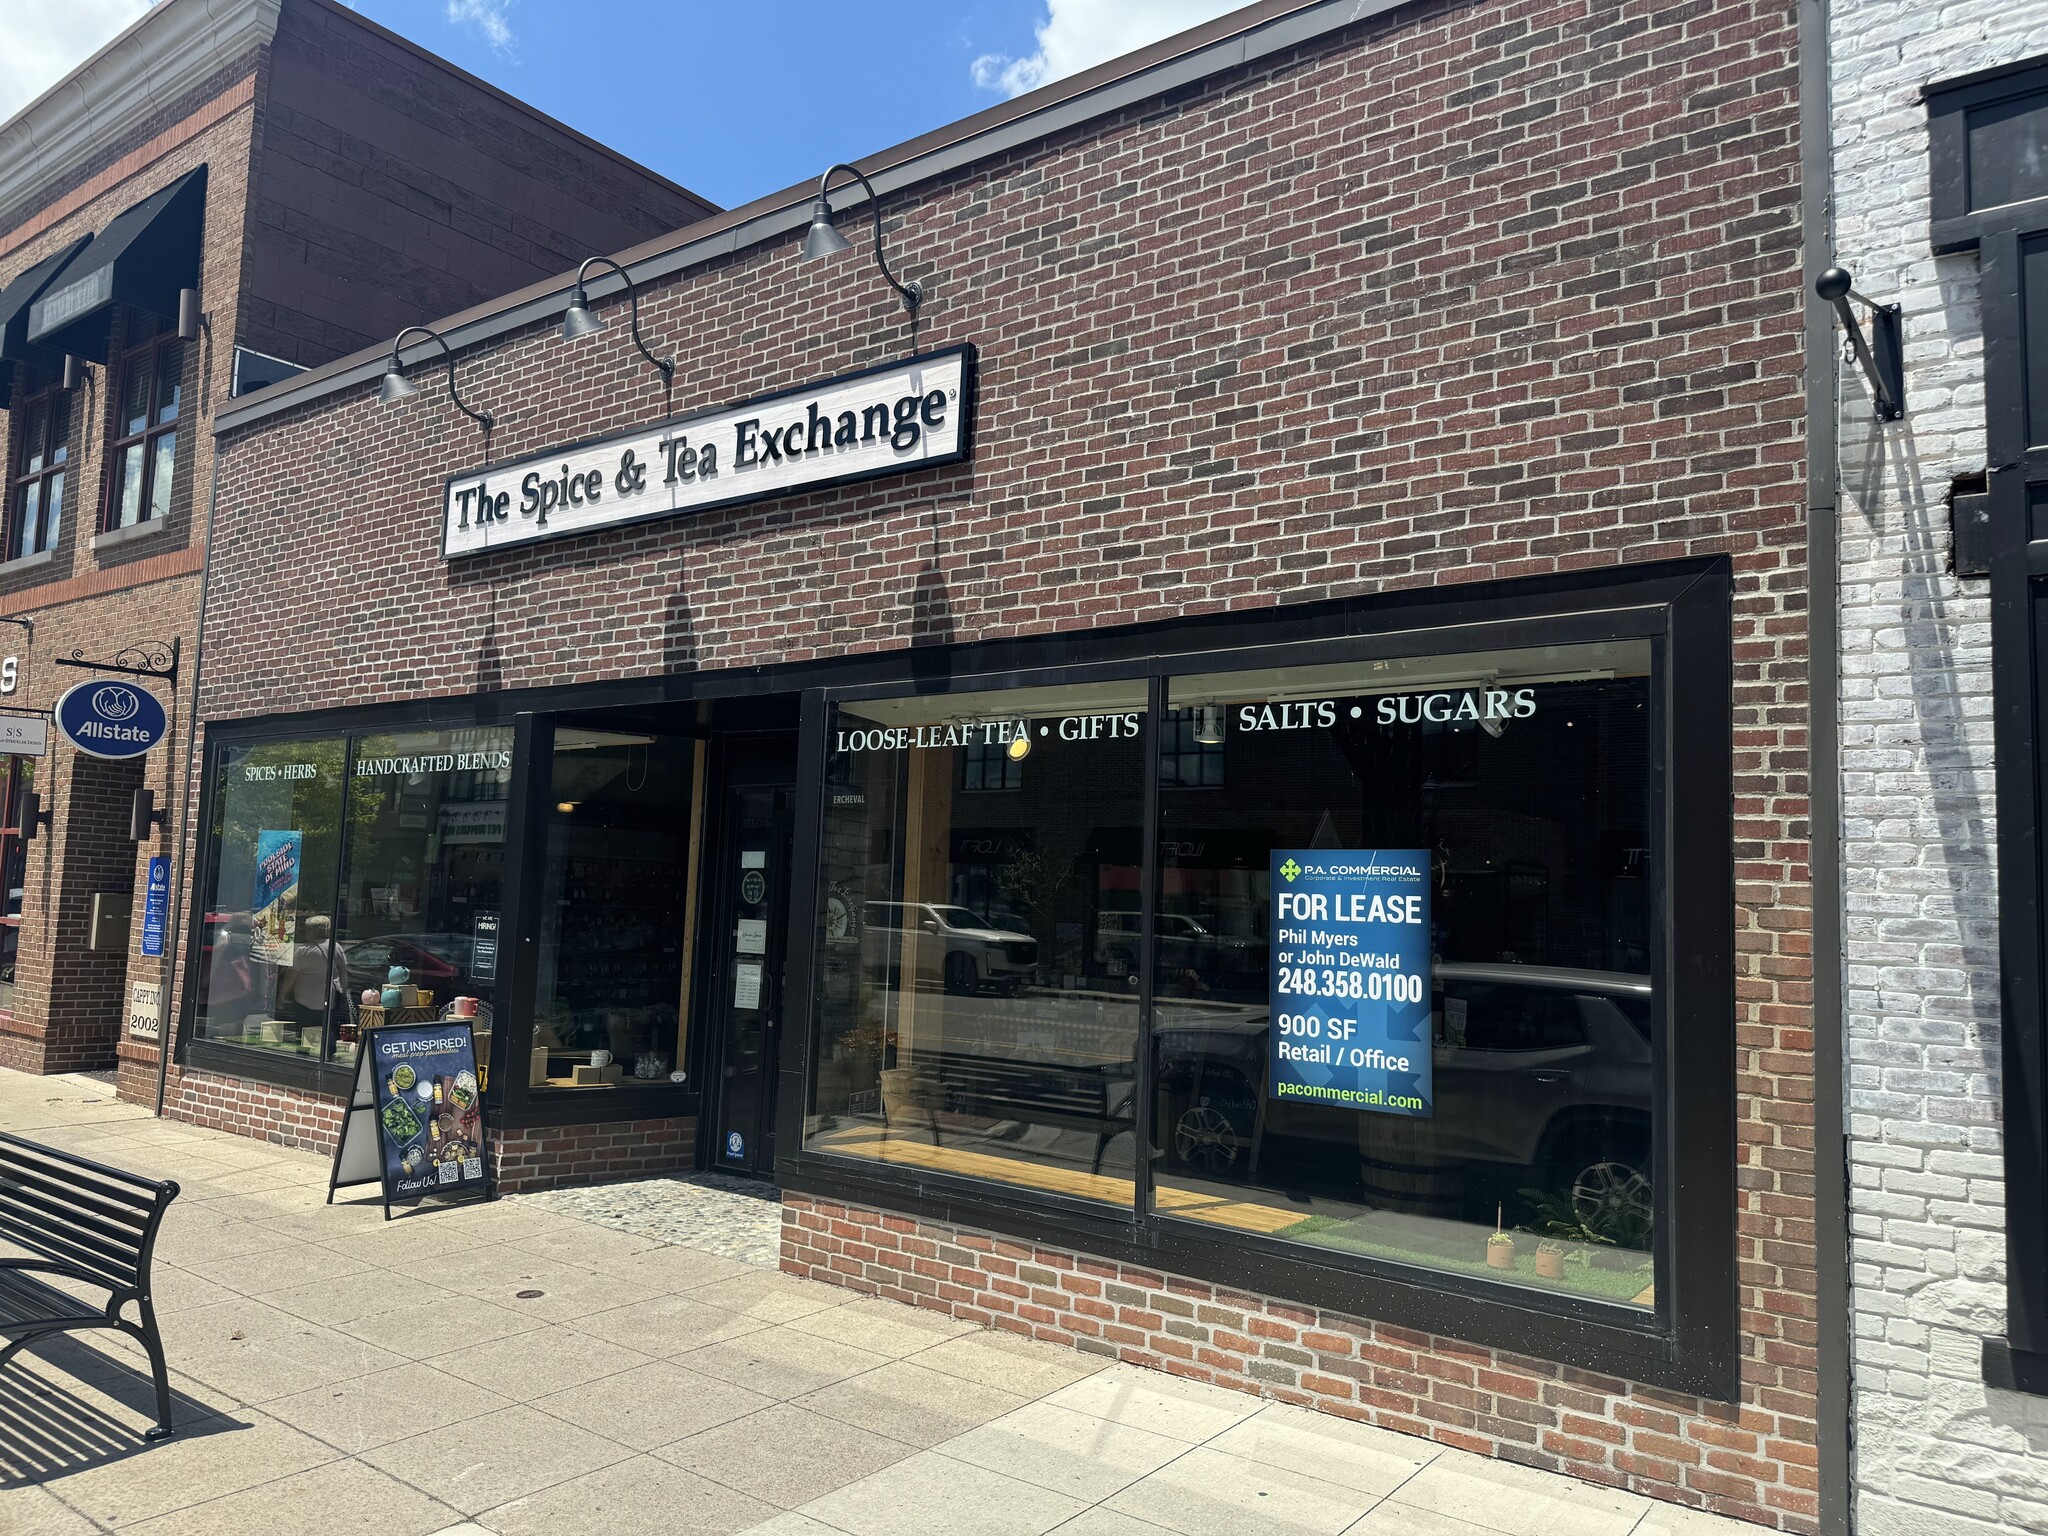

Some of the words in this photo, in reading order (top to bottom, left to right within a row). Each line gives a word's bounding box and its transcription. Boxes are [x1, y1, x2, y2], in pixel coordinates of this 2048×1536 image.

[455, 488, 510, 528] The
[520, 464, 603, 524] Spice
[614, 448, 646, 494] &
[659, 435, 718, 483] Tea
[734, 388, 947, 469] Exchange
[1239, 701, 1336, 732] SALTS
[1376, 688, 1536, 725] SUGARS
[76, 721, 150, 742] Allstate
[837, 723, 974, 752] LOOSE-LEAF
[980, 720, 1031, 745] TEA
[1058, 713, 1140, 741] GIFTS
[245, 766, 276, 782] SPICES
[283, 764, 317, 780] HERBS
[356, 754, 453, 776] HANDCRAFTED
[456, 751, 510, 771] BLENDS
[259, 841, 294, 872] POOLSIDE
[267, 853, 289, 873] STATE
[265, 872, 275, 884] OF
[275, 857, 295, 877] MIND
[1304, 865, 1327, 875] P.A.
[1330, 865, 1421, 876] COMMERCIAL
[1278, 893, 1328, 921] FOR
[1335, 894, 1422, 924] LEASE
[1279, 929, 1307, 945] Phil
[1311, 930, 1358, 949] Myers
[1278, 952, 1294, 964] or
[1297, 950, 1335, 966] John
[1339, 951, 1400, 969] DeWald
[1278, 967, 1422, 1003] 248.358.0100
[131, 1014, 159, 1033] 2002
[1278, 1014, 1320, 1038] 900
[1327, 1018, 1358, 1041] SF
[382, 1041, 408, 1055] GET
[409, 1036, 467, 1051] INSPIRED!
[391, 1049, 410, 1059] meal
[409, 1051, 425, 1060] prep
[1279, 1041, 1331, 1064] Retail
[1336, 1047, 1345, 1066] /
[1350, 1048, 1409, 1072] Office
[1278, 1080, 1423, 1109] pacommercial.com
[396, 1179, 422, 1193] Follow
